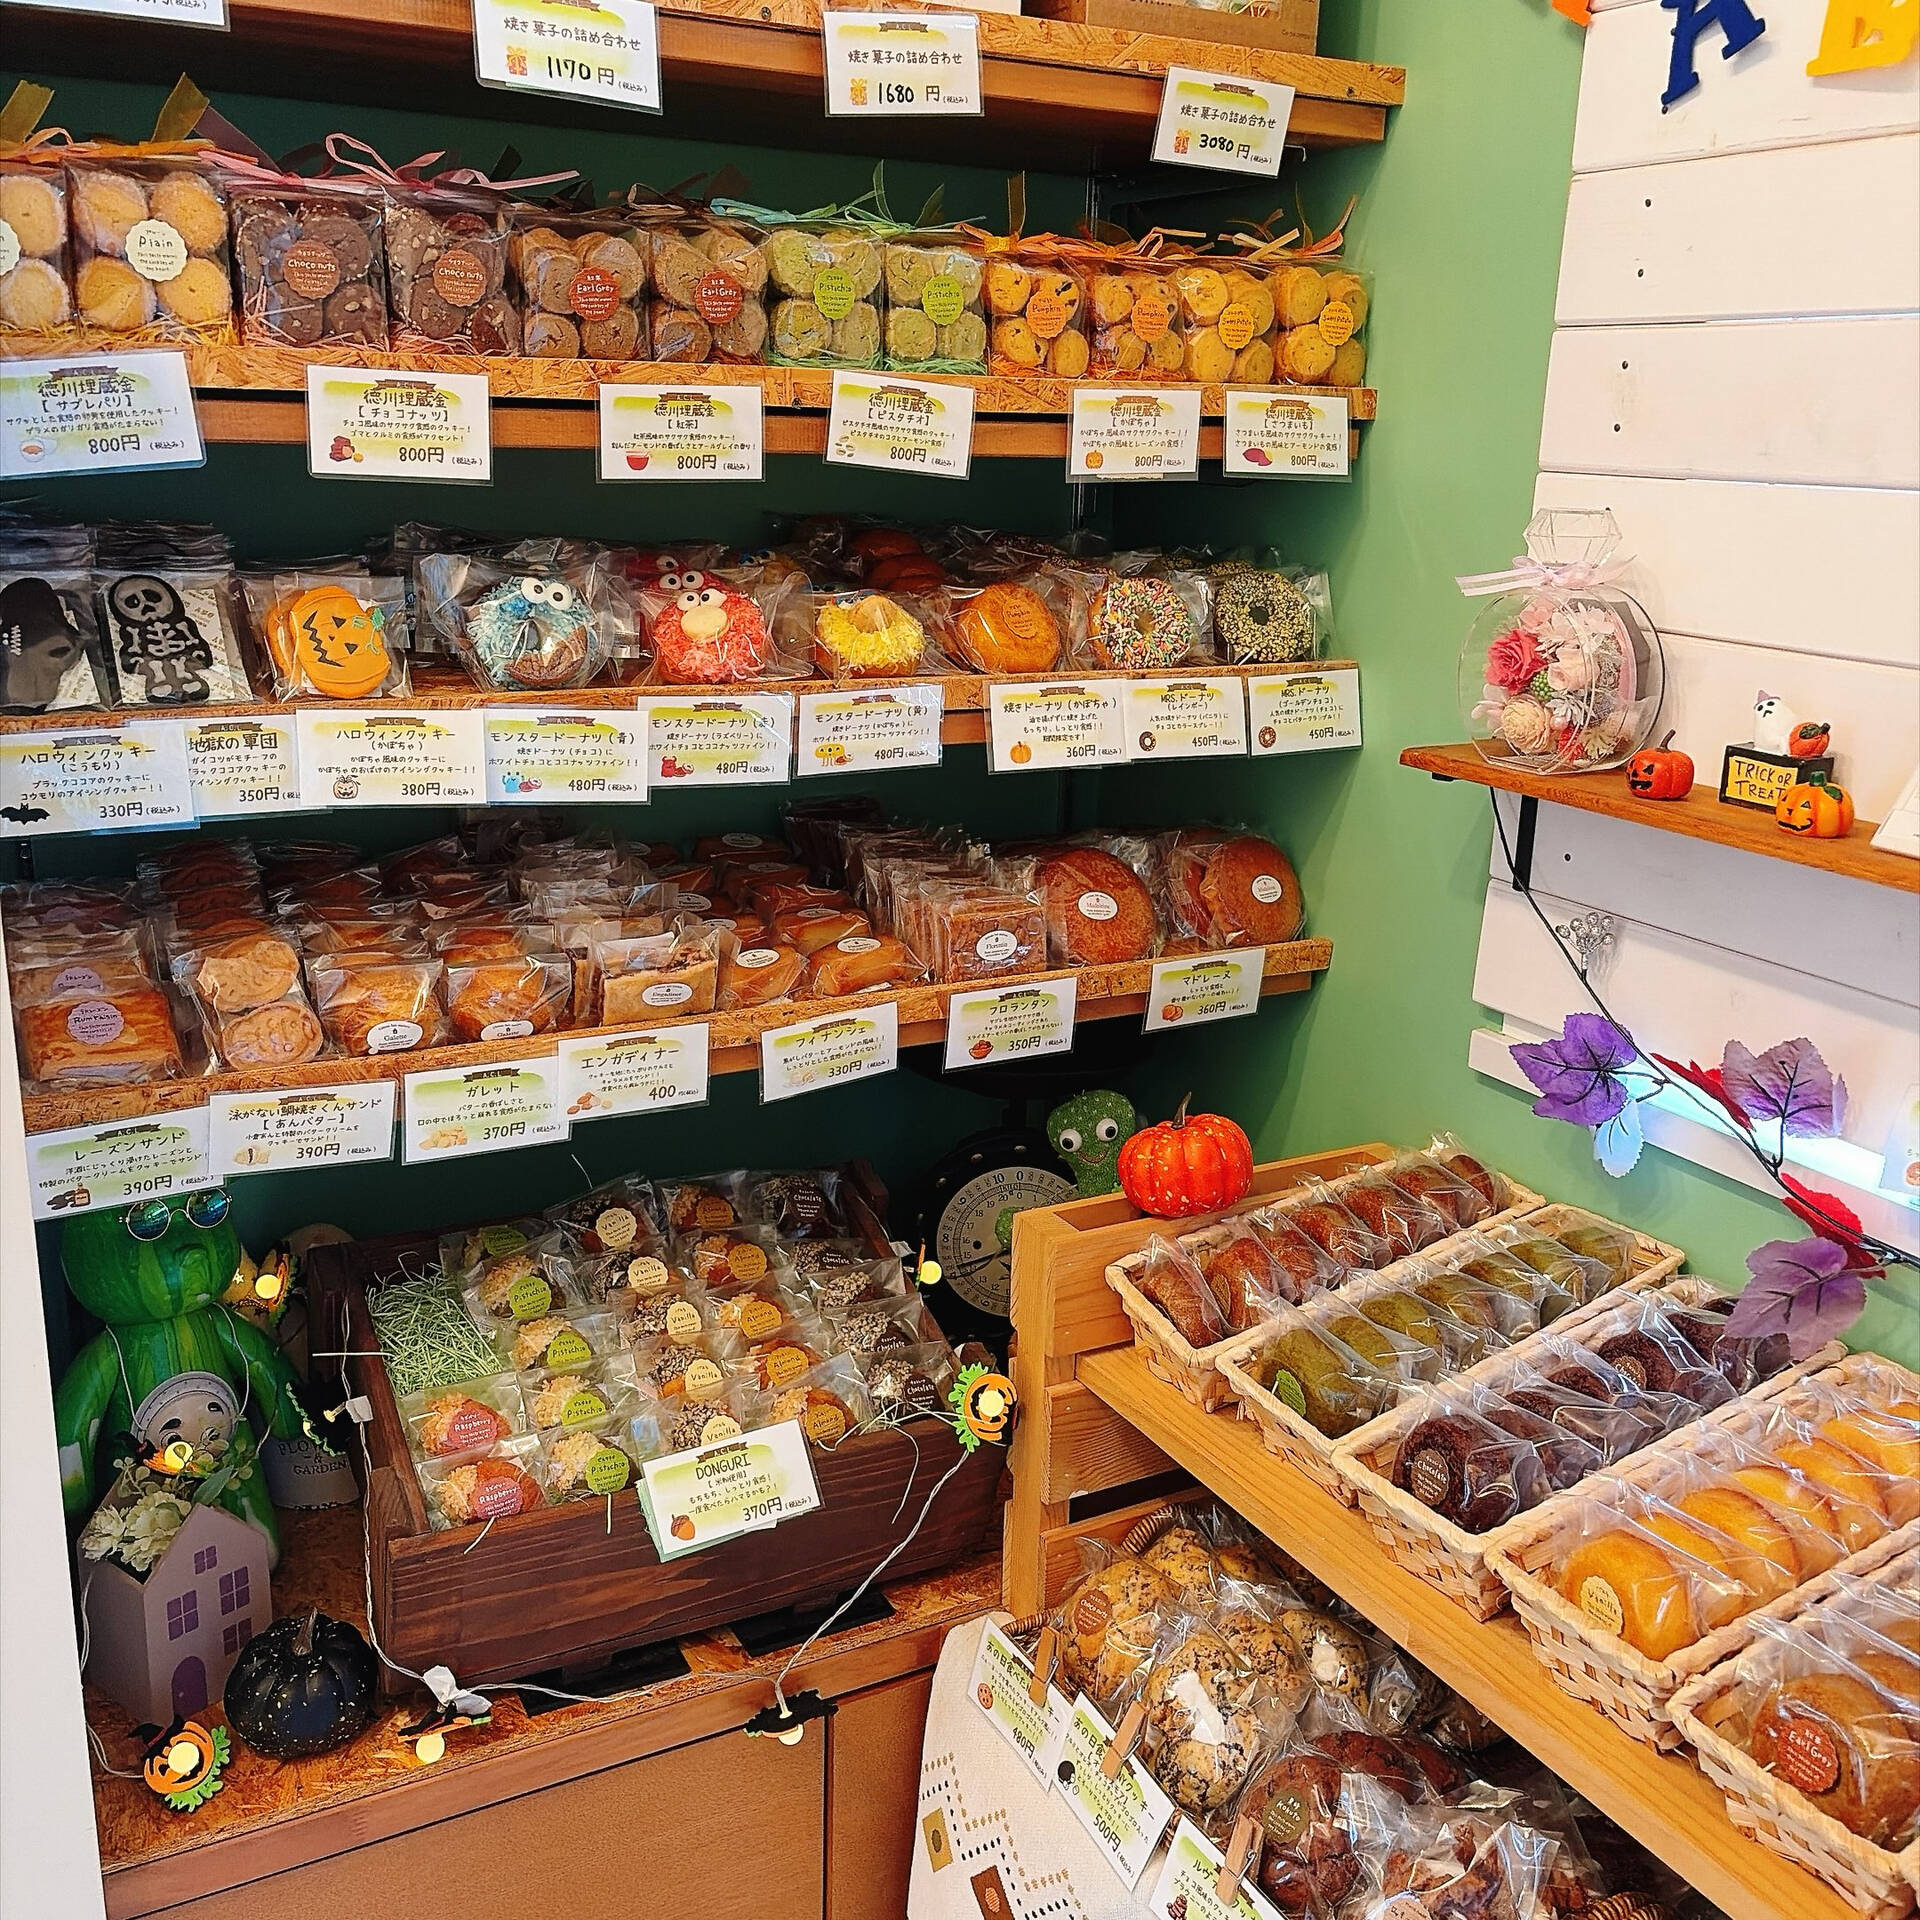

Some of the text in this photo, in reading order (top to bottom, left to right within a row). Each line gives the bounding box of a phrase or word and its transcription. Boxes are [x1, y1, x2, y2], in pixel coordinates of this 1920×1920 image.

[503, 17, 641, 51] 焼き菓子の詰め合わせ
[847, 48, 963, 65] 焼き菓子の詰め合わせ
[547, 56, 591, 82] 1170
[597, 67, 614, 86] 円
[877, 82, 914, 104] 1680
[925, 85, 940, 102] 円
[1180, 103, 1277, 128] 焼き菓子の詰め合わせ
[1199, 133, 1234, 152] 3080
[1236, 143, 1250, 160] 円
[139, 235, 173, 248] Plain
[287, 259, 316, 269] Choco
[439, 267, 464, 278] Choco
[38, 376, 136, 397] 徳川埋蔵金
[363, 388, 450, 410] 徳川埋蔵金
[868, 393, 936, 415] 徳川埋蔵金
[653, 403, 717, 418] 徳川埋蔵金
[867, 408, 930, 426] 【ピスタチオ】
[1110, 404, 1164, 418] 徳川埋蔵金
[1265, 406, 1315, 421] 徳川埋蔵金
[667, 419, 698, 430] 【紅茶】
[88, 434, 140, 454] 800円
[398, 447, 444, 464] 800円
[676, 454, 717, 470] 800円
[890, 446, 927, 463] 800円
[1134, 454, 1162, 467] 800円
[1290, 454, 1317, 467] 800円
[336, 728, 456, 741] ハロウィンクッキー
[1191, 734, 1219, 748] 450円
[1308, 726, 1334, 740] 450円
[188, 732, 278, 753] 地獄の軍団
[1066, 744, 1096, 758] 360円
[21, 746, 156, 764] ハロウィンクッキー
[191, 753, 277, 765] ガイコツがモチーフの
[874, 747, 904, 760] 480円
[716, 761, 748, 774] 480円
[1735, 760, 1792, 784] TRICK OR
[401, 782, 440, 796] 380円
[568, 779, 605, 792] 480円
[1735, 780, 1786, 802] TREAT
[239, 787, 280, 802] 350円
[99, 801, 142, 820] 330円
[1182, 970, 1232, 986] マドレーヌ
[989, 998, 1050, 1016] フロランタン
[1197, 1001, 1226, 1016] 360円
[796, 1025, 866, 1048] フィナンシェ
[1008, 1036, 1041, 1052] 350円
[581, 1047, 680, 1070] エンガディナー
[828, 1060, 862, 1078] 330円
[465, 1081, 520, 1098] ガレット
[648, 1084, 676, 1100] 400
[228, 1099, 382, 1120] 泳がない鯛焼きくんサンド
[262, 1113, 346, 1130] 【あんバター】
[482, 1121, 526, 1140] 370円
[74, 1131, 185, 1161] レーズンサンド
[296, 1142, 340, 1159] 390円
[122, 1174, 172, 1196] 390円
[670, 1310, 696, 1322] Vanilla
[745, 1309, 772, 1322] Almond
[772, 1354, 800, 1368] Almond
[690, 1370, 718, 1380] Vanilla
[453, 1416, 492, 1431] Raspberry
[706, 1425, 737, 1442] Vanilla
[695, 1453, 752, 1479] DONGURI
[478, 1487, 520, 1504] Raspberry
[743, 1495, 782, 1520] 370円
[1012, 1726, 1034, 1758] 480円
[1787, 1728, 1832, 1768] Earl Grey
[1276, 1800, 1300, 1822] Kokuto
[1092, 1813, 1121, 1852] 500円
